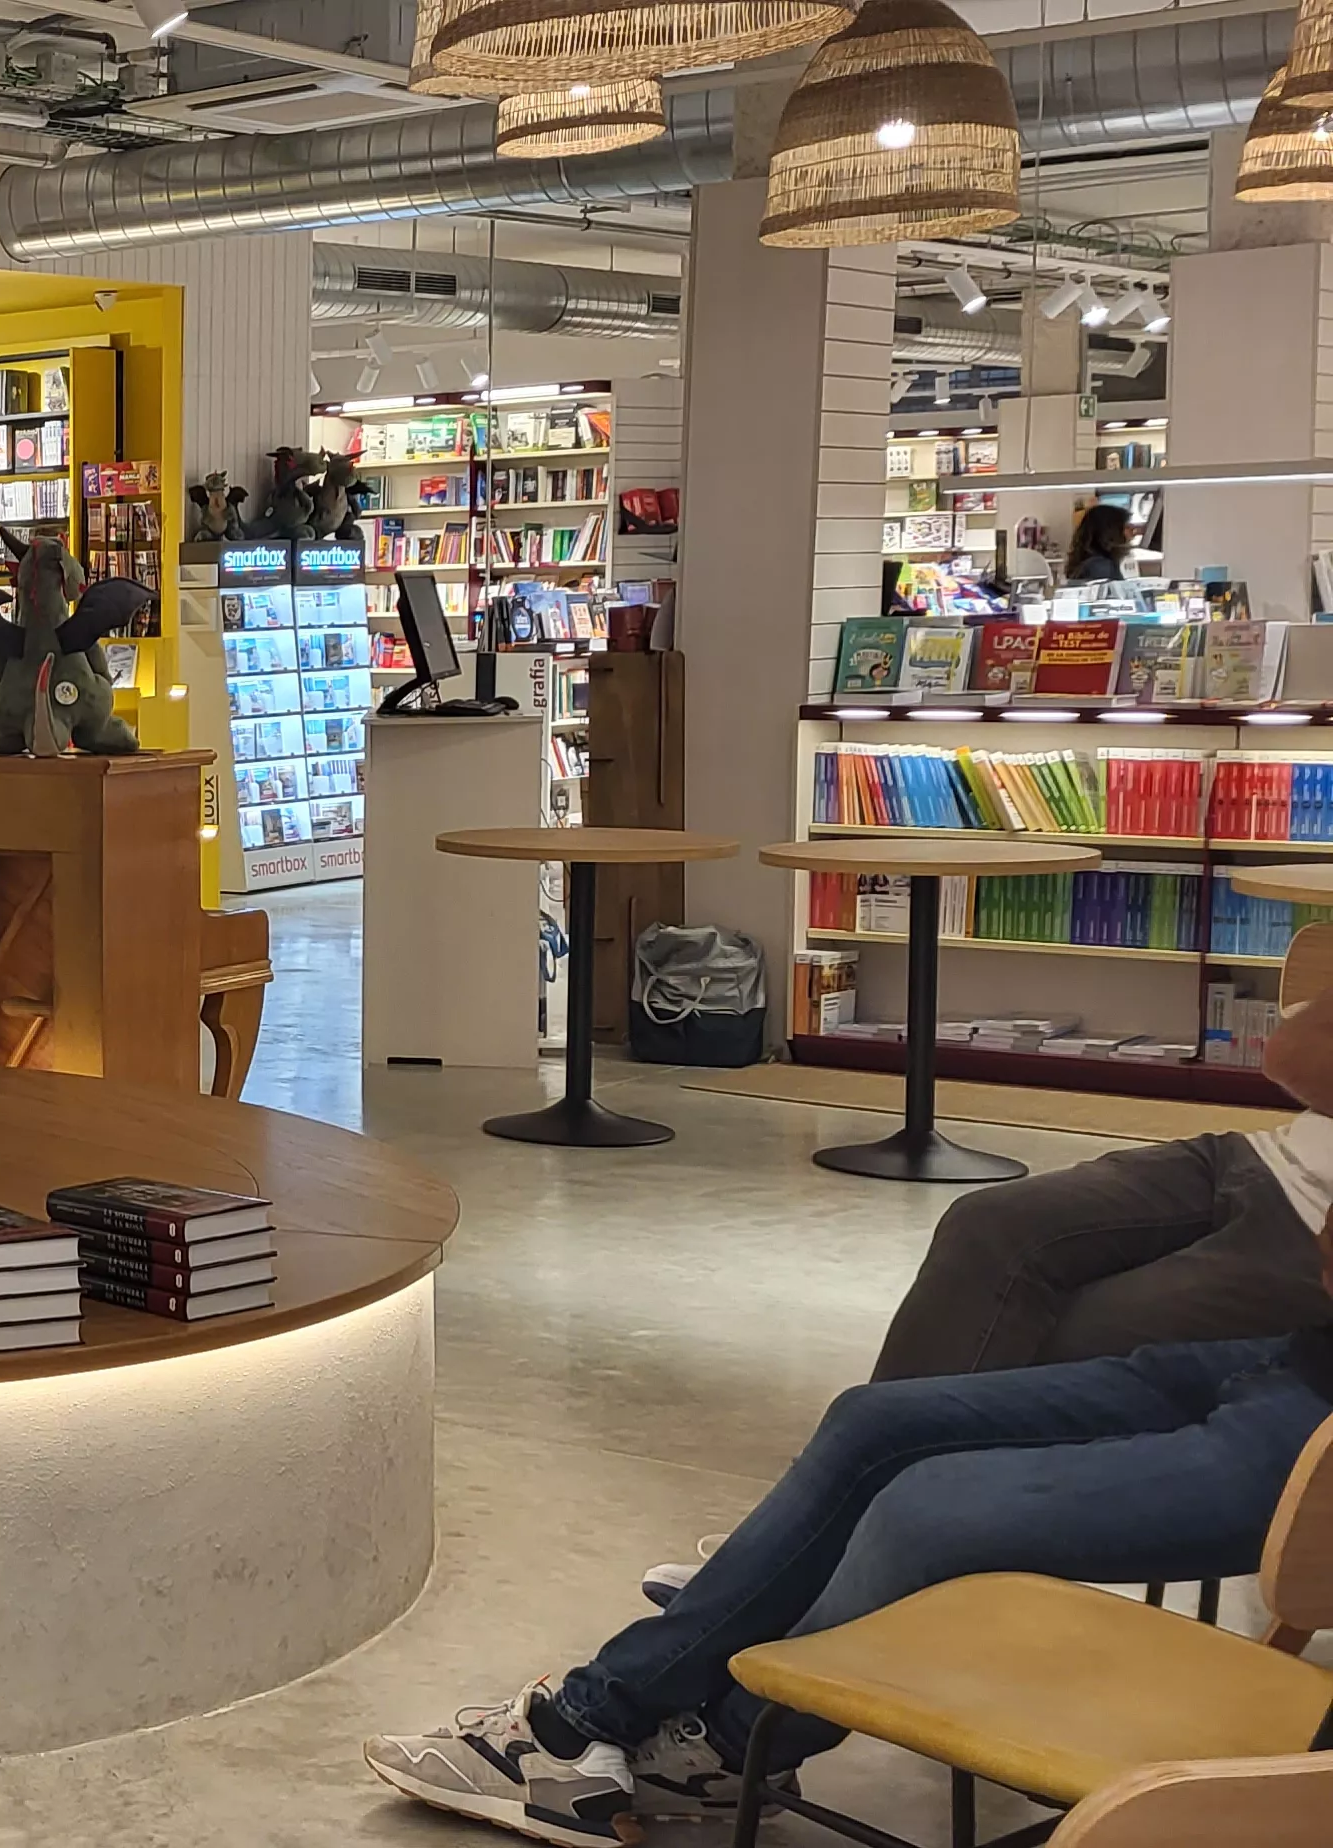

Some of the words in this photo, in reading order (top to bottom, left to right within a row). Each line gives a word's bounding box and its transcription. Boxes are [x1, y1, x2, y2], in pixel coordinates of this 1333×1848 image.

[224, 546, 286, 567] smartbox
[301, 546, 361, 566] smartbox
[529, 658, 548, 711] grafía
[251, 856, 307, 877] smartbox
[320, 848, 364, 868] smartb
